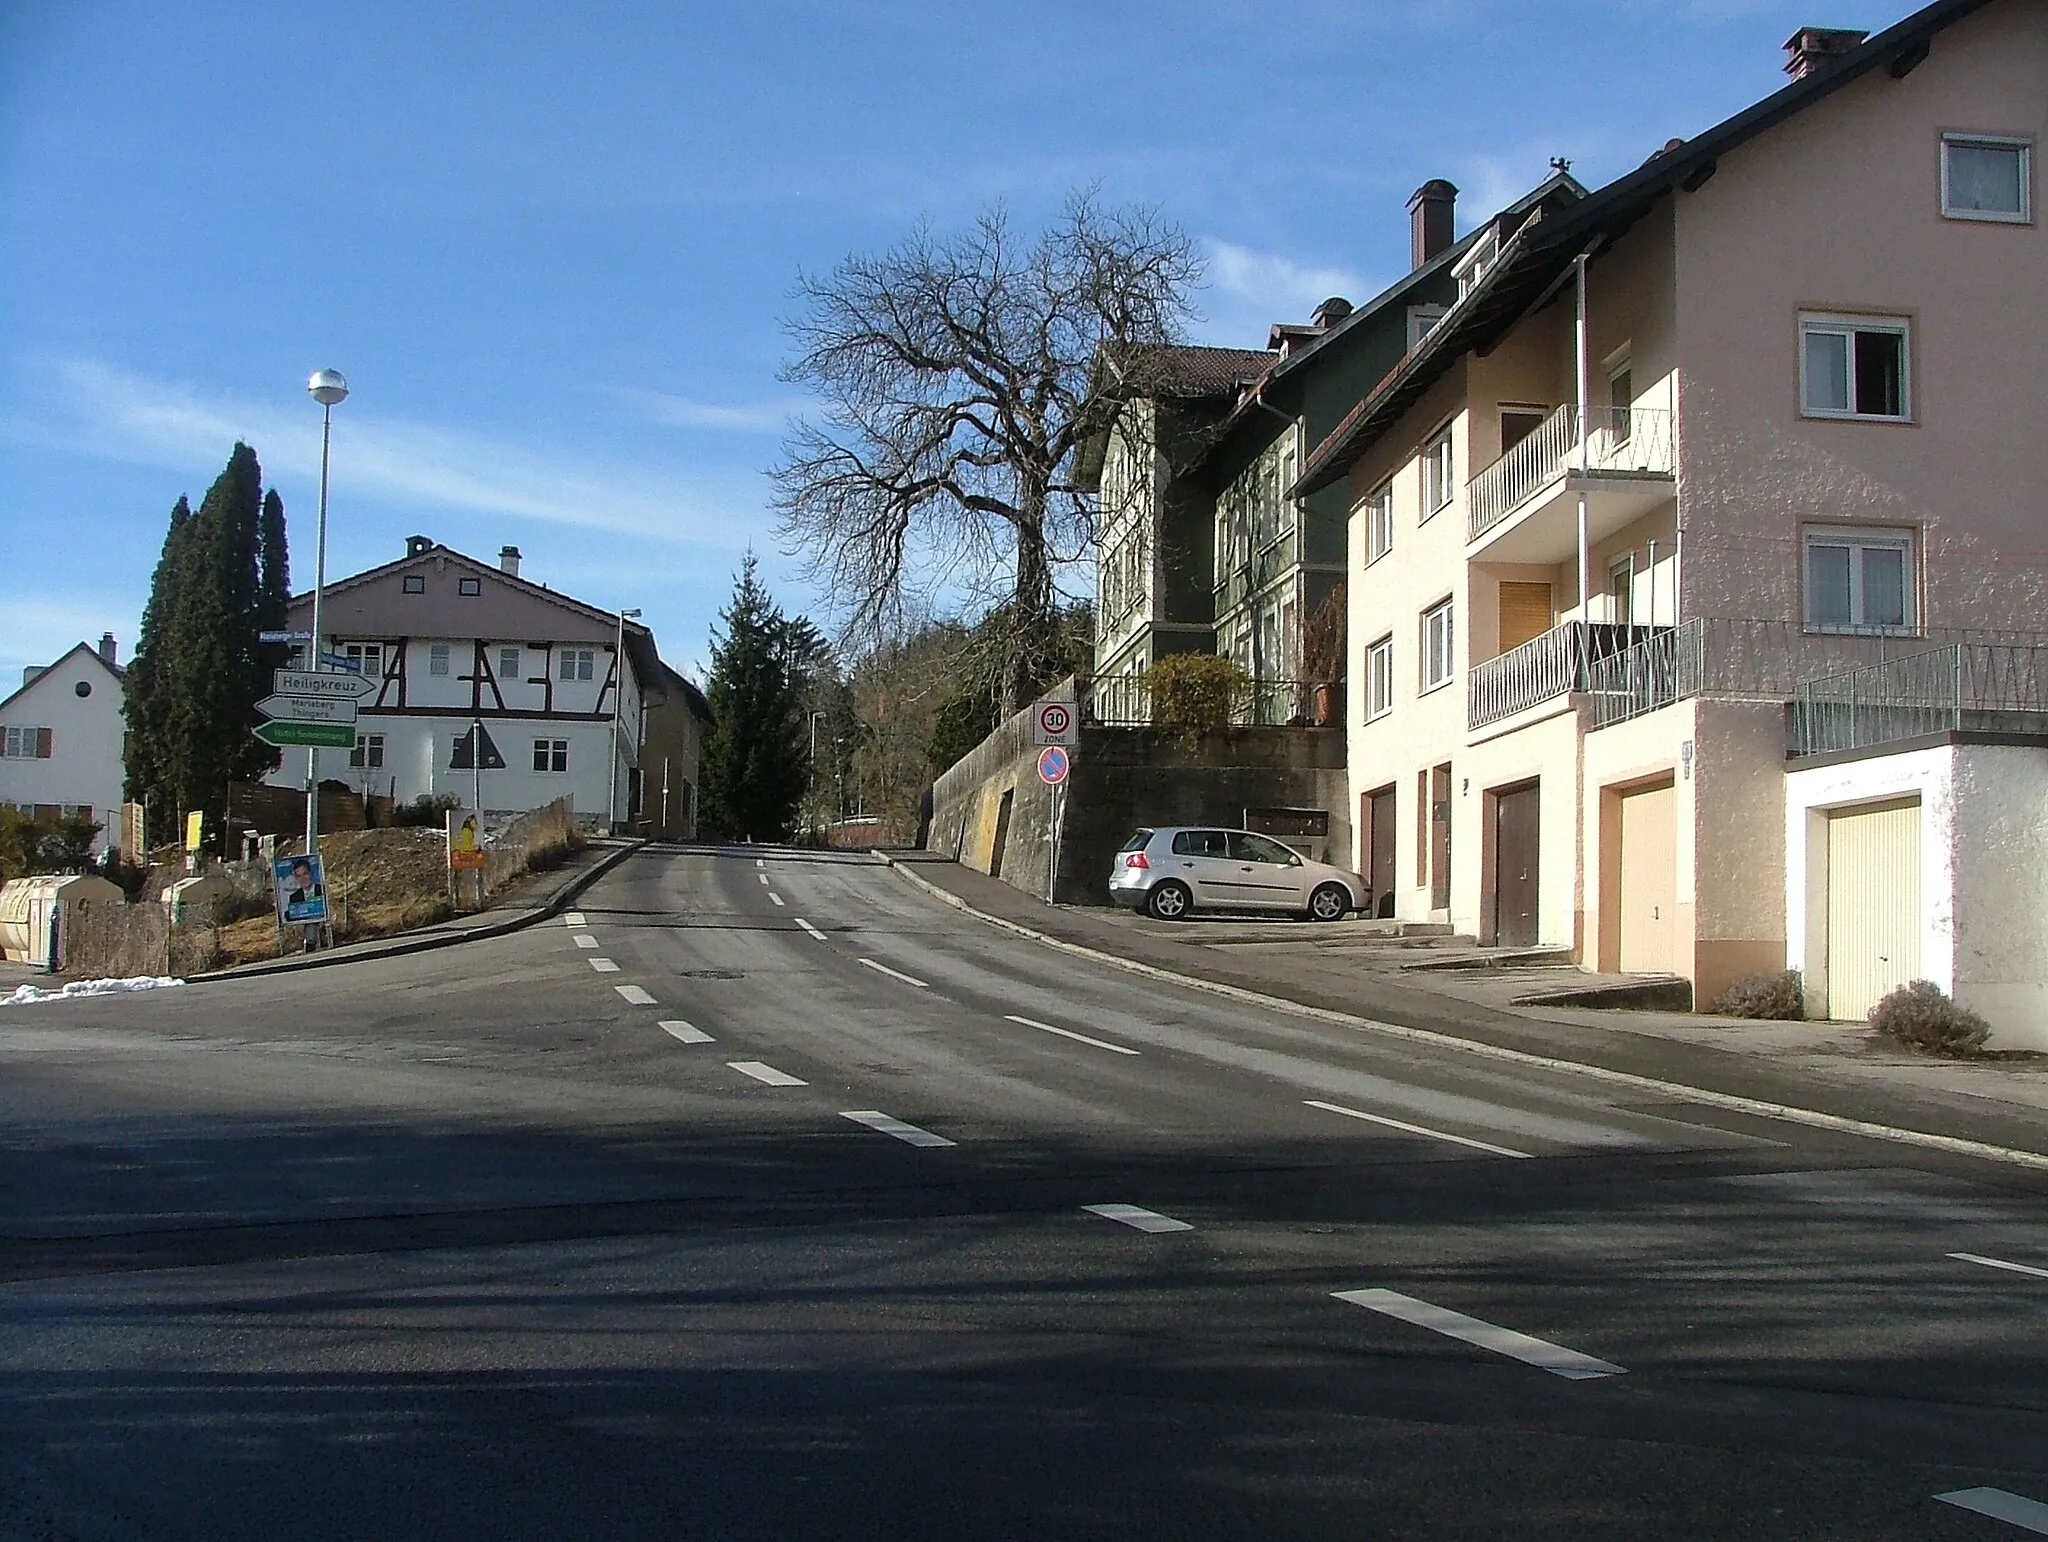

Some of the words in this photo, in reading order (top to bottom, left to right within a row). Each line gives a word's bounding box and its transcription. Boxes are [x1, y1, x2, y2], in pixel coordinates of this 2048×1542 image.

[283, 676, 358, 692] Heiligkreuz
[1047, 713, 1063, 726] 30
[1044, 735, 1066, 743] ZONE
